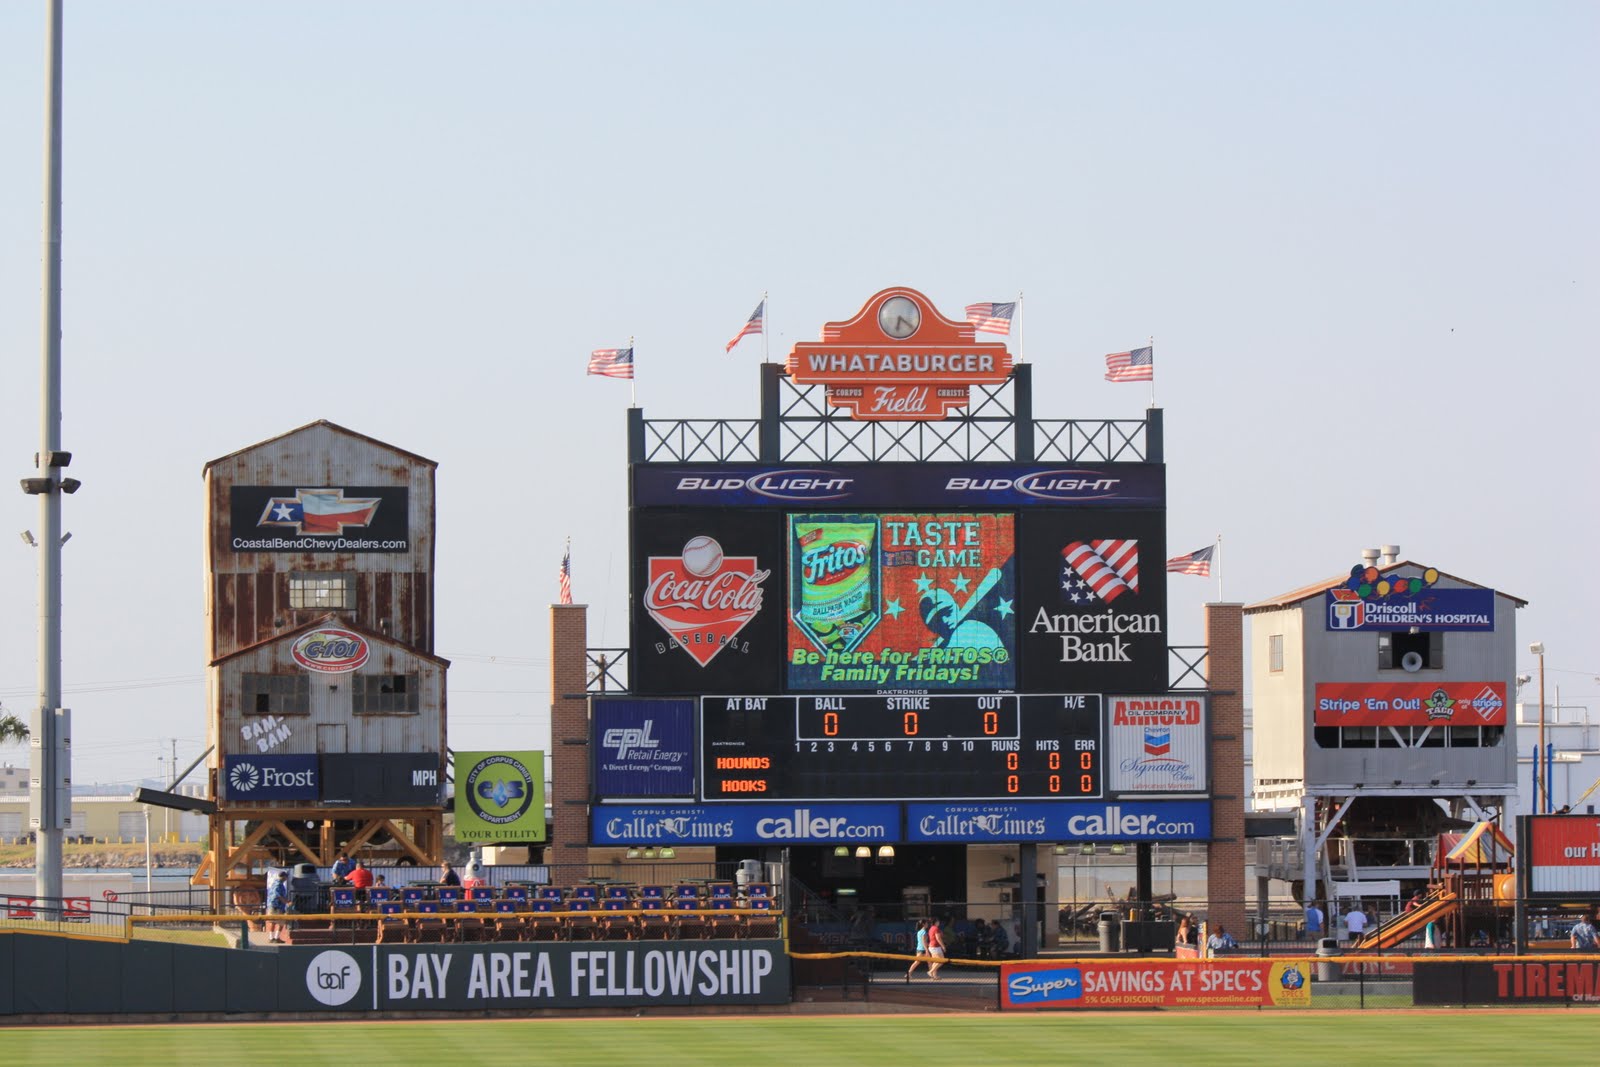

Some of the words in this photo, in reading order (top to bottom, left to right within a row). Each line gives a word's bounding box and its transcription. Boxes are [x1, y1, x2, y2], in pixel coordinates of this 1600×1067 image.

[808, 354, 995, 373] WHATABURGER
[871, 385, 929, 412] Field
[937, 388, 964, 397] CHRISTI
[676, 478, 745, 490] BUD
[760, 478, 853, 490] LIGHT
[945, 478, 1015, 490] BUD
[1028, 478, 1120, 490] LIGHT
[886, 521, 981, 547] TASTE
[233, 538, 406, 550] CoastalBendChevyDealers.com
[802, 544, 866, 585] Fritos
[917, 549, 981, 568] GAME
[644, 569, 771, 611] Coca-Cola
[1365, 602, 1416, 614] Driscoll
[1029, 606, 1161, 633] American
[1365, 614, 1432, 624] CHILDREN'S
[1435, 614, 1490, 624] HOSPITAL
[304, 640, 360, 658] C-101
[655, 633, 750, 654] BASEBALL
[1060, 635, 1132, 662] Bank
[792, 649, 819, 665] Be
[826, 648, 878, 665] here
[880, 648, 911, 665] for
[821, 664, 890, 684] Family
[895, 664, 979, 684] Fridays!
[727, 698, 743, 710] AT
[745, 698, 767, 710] BAT
[814, 698, 846, 710] BALL
[886, 697, 930, 710] STRIKE
[977, 697, 1002, 709] OUT
[1064, 696, 1085, 709] H/E
[1319, 698, 1360, 714] Stripe
[1364, 698, 1388, 710] 'Em
[1393, 698, 1420, 710] Out!
[1425, 707, 1454, 715] TACO
[1472, 698, 1503, 708] stripes
[1113, 700, 1200, 726] ARNOLD
[824, 712, 838, 736] 0
[904, 711, 918, 735] 0
[984, 711, 998, 735] 0
[257, 724, 292, 752] BAM
[795, 741, 800, 752] 1
[811, 741, 817, 752] 2
[828, 741, 834, 752] 3
[851, 741, 858, 752] 4
[868, 741, 875, 752] 5
[885, 741, 891, 752] 6
[908, 741, 914, 752] 7
[925, 741, 931, 752] 8
[942, 741, 948, 751] 9
[961, 741, 974, 751] 10
[991, 740, 1020, 751] RUNS
[1036, 740, 1059, 751] HITS
[1074, 740, 1095, 750] ERR
[627, 750, 652, 760] Retail
[717, 757, 770, 769] HOUNDS
[1007, 752, 1018, 770] 0
[1049, 752, 1060, 770] 0
[1081, 752, 1091, 770] 0
[468, 769, 479, 784] CITY
[477, 762, 487, 771] OF
[486, 756, 513, 765] CORPUS
[513, 760, 532, 783] CHRISTI
[654, 764, 683, 773] Company
[1120, 757, 1190, 778] Signature
[262, 767, 314, 787] Frost
[413, 769, 437, 786] MPH
[722, 780, 767, 792] HOOKS
[1007, 775, 1019, 793] 0
[1049, 775, 1060, 792] 0
[1081, 774, 1091, 792] 0
[479, 811, 522, 824] DEPARTMENT
[756, 809, 885, 839] caller.com
[919, 815, 977, 836] Caller
[989, 814, 1045, 835] Times
[1068, 806, 1194, 836] caller.com
[462, 830, 492, 838] YOUR
[496, 829, 539, 838] UTILITY
[606, 818, 662, 839] Caller
[675, 817, 733, 839] Times
[1564, 846, 1588, 858] our
[9, 900, 89, 914] PS
[316, 966, 350, 990] baf
[388, 953, 452, 999] BAY
[467, 952, 555, 998] AREA
[571, 949, 773, 996] FELLOWSHIP
[1084, 970, 1165, 992] SAVINGS
[1170, 970, 1195, 991] AT
[1200, 970, 1262, 991] SPEC'S
[1493, 964, 1600, 997] TIREM
[1009, 976, 1077, 997] Super
[1085, 996, 1098, 1004] 5%
[1100, 996, 1121, 1004] CASH
[1123, 995, 1165, 1004] DISCOUNT
[1176, 996, 1263, 1004] www.specsonline.com
